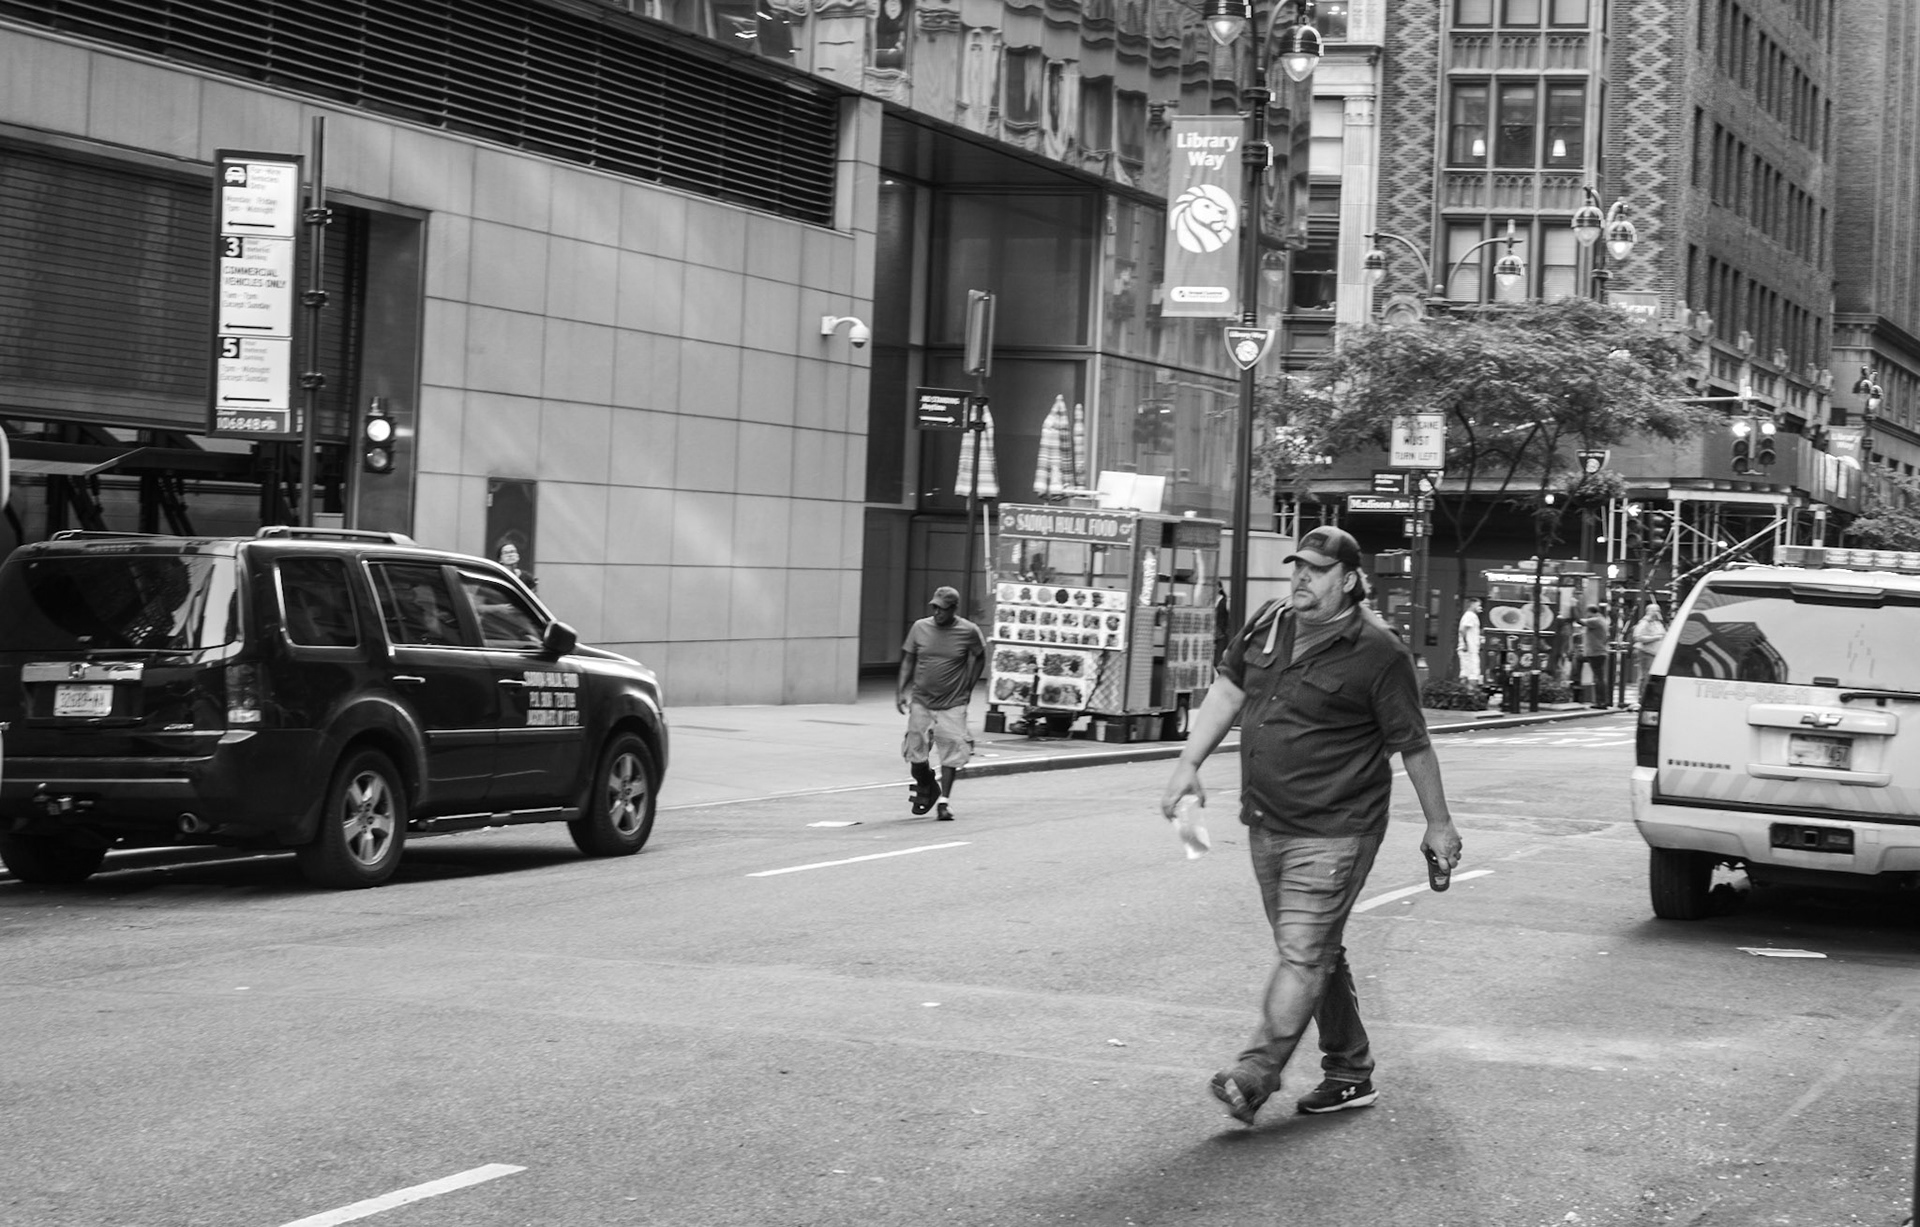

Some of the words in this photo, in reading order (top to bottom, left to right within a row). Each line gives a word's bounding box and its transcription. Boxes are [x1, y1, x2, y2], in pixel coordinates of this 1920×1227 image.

[1176, 132, 1238, 152] Library
[1188, 151, 1226, 170] Way
[225, 237, 240, 257] 3
[224, 265, 279, 278] COMMERCIAL
[224, 276, 263, 288] VEHICLES
[265, 279, 287, 289] ONLY
[222, 337, 237, 358] 5
[1395, 451, 1416, 460] TURN
[1418, 451, 1438, 461] LEFT
[1350, 499, 1391, 509] Madison
[1016, 513, 1054, 535] SADIQA
[1055, 516, 1087, 535] HALAL
[1088, 518, 1118, 537] FOOD
